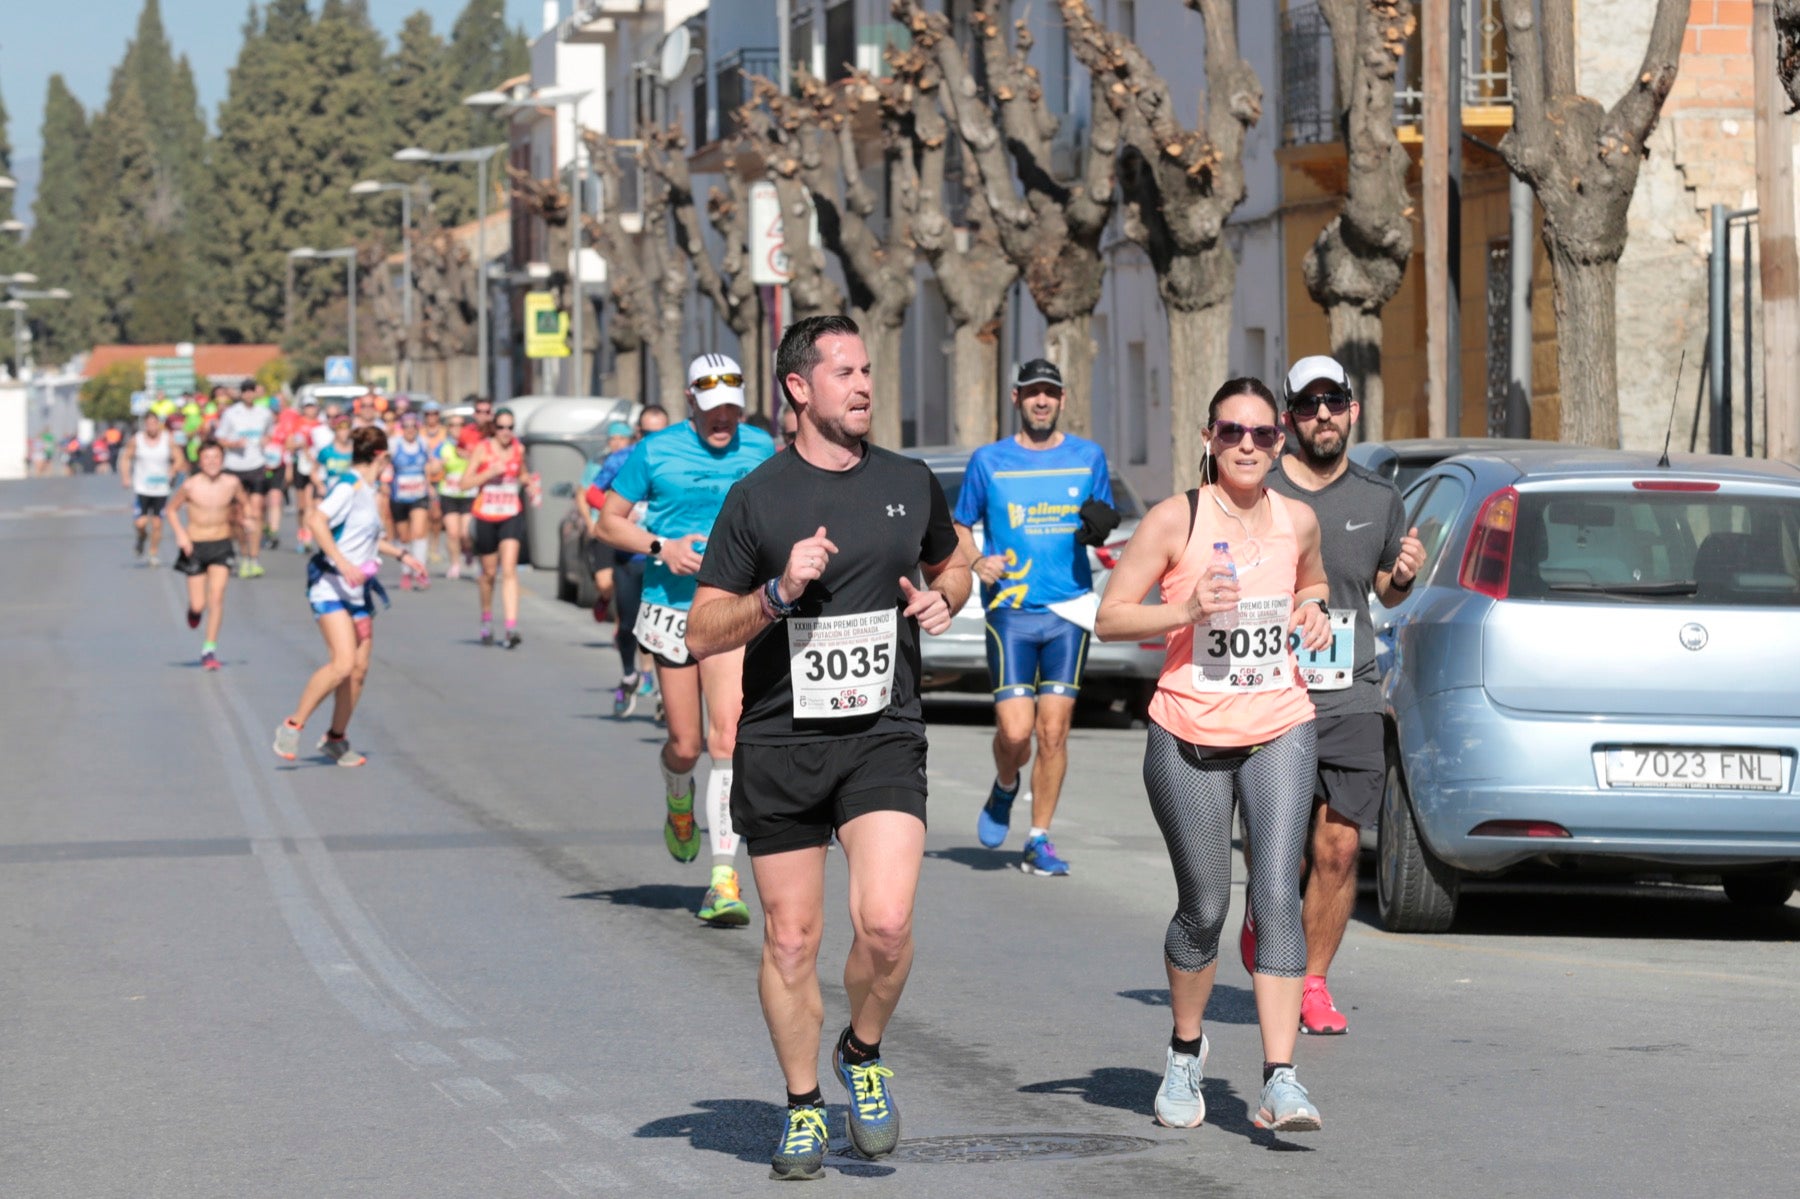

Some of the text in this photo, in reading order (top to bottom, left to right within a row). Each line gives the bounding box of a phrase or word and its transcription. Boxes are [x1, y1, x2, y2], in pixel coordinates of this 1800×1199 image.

[1029, 502, 1080, 516] olimpo
[1240, 601, 1262, 610] PREMIO
[1263, 600, 1270, 609] DE
[643, 604, 686, 639] 3119
[807, 626, 879, 639] DIPUTACIÓN DE GRANADA
[814, 621, 832, 630] GRAN
[833, 618, 858, 629] PREMIO
[860, 617, 868, 626] DE
[869, 614, 890, 625] FONDO
[1207, 625, 1282, 659] 3033
[804, 643, 890, 681] 3035
[1634, 750, 1773, 781] 7023 FNL
